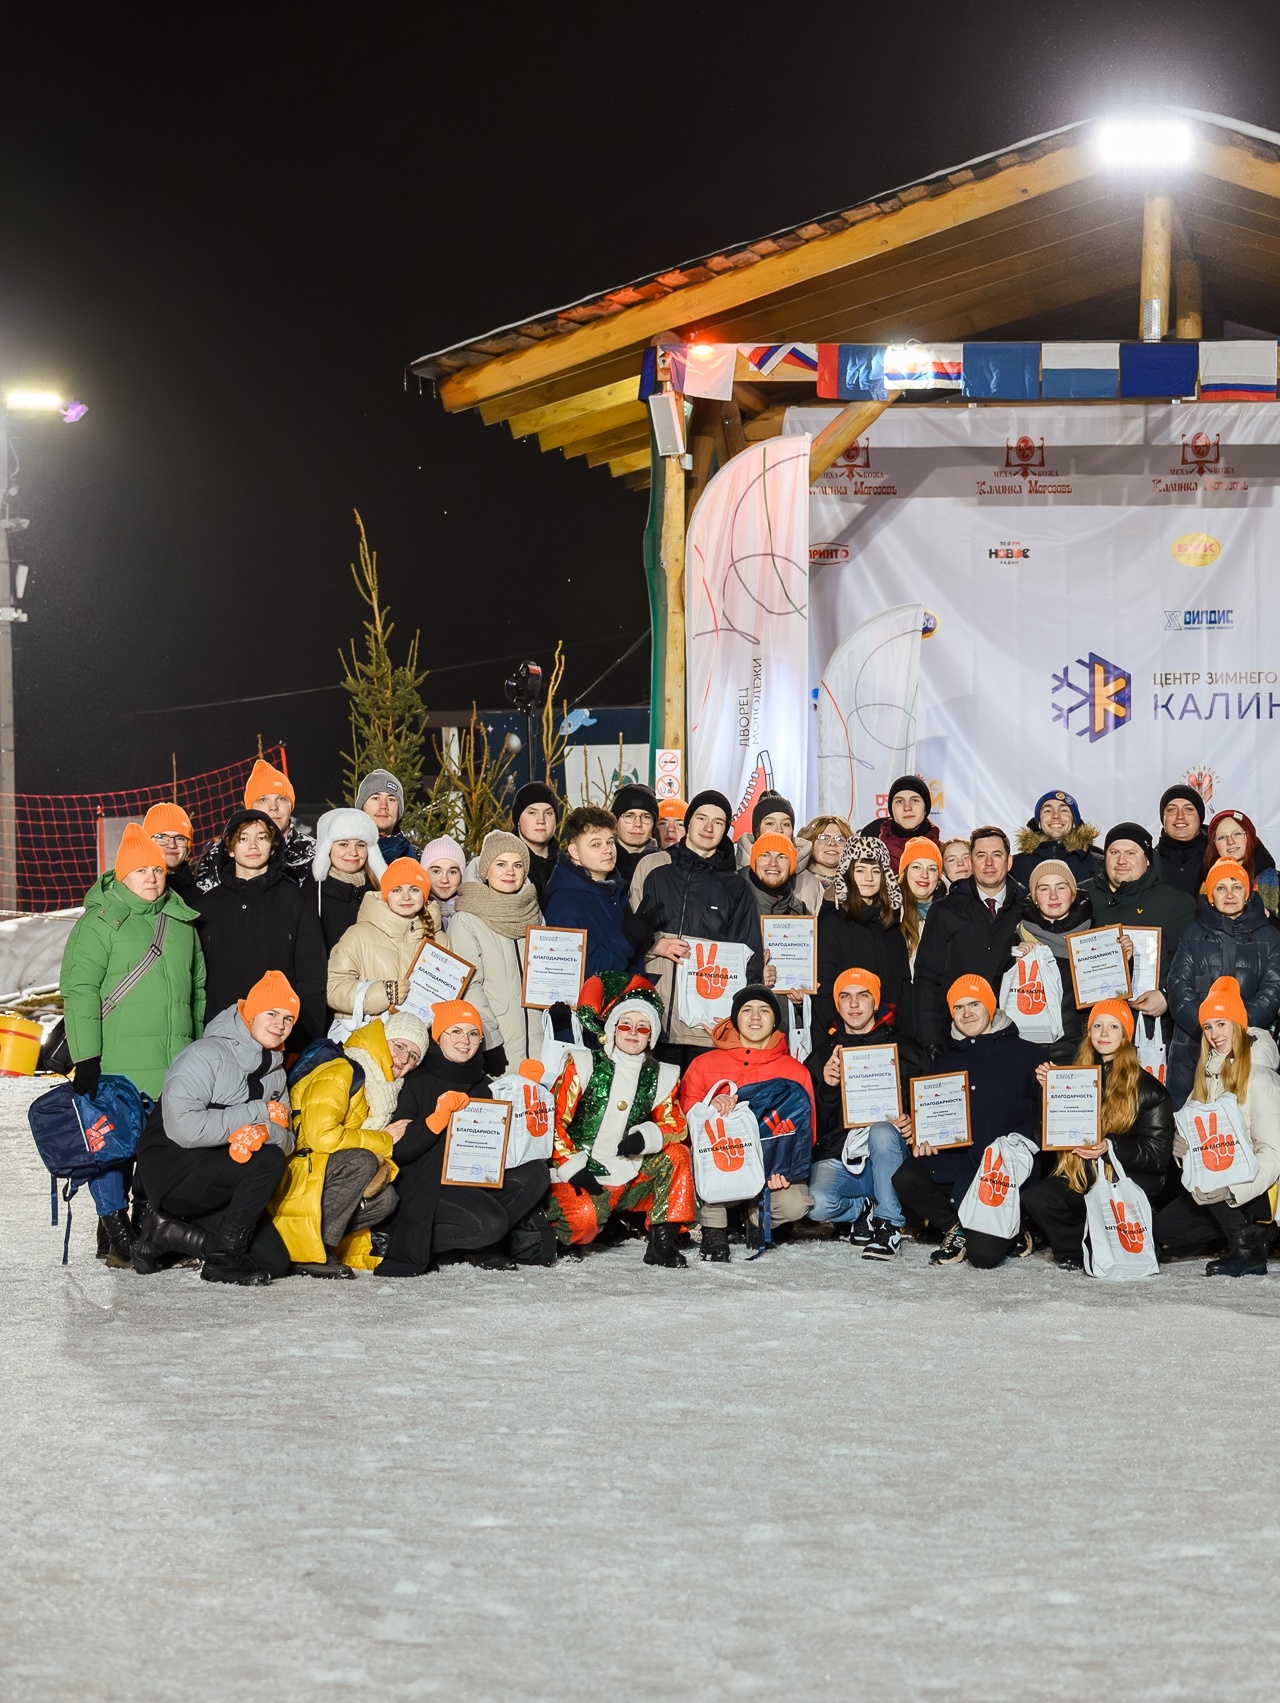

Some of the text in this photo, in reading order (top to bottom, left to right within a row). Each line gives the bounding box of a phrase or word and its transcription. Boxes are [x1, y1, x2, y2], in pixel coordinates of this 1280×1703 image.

[993, 470, 1013, 478] МЕХА
[1183, 609, 1234, 625] ВИЛДИС
[1153, 671, 1201, 688] ЦЕНТР
[1206, 670, 1278, 686] ЗИМНЕГО
[738, 686, 751, 748] ДВОРЕЦ
[533, 954, 578, 963] БЛАГОДАРНОСТЬ
[1077, 949, 1119, 963] БЛАГОДАРНОСТЬ
[848, 1072, 892, 1080] БЛАГОДАРНОСТЬ
[919, 1097, 963, 1107] БЛАГОДАРНОСТЬ
[456, 1127, 501, 1136] БЛАГОДАРНОСТЬ
[1192, 1140, 1241, 1153] ЯТКА МОЛОДА
